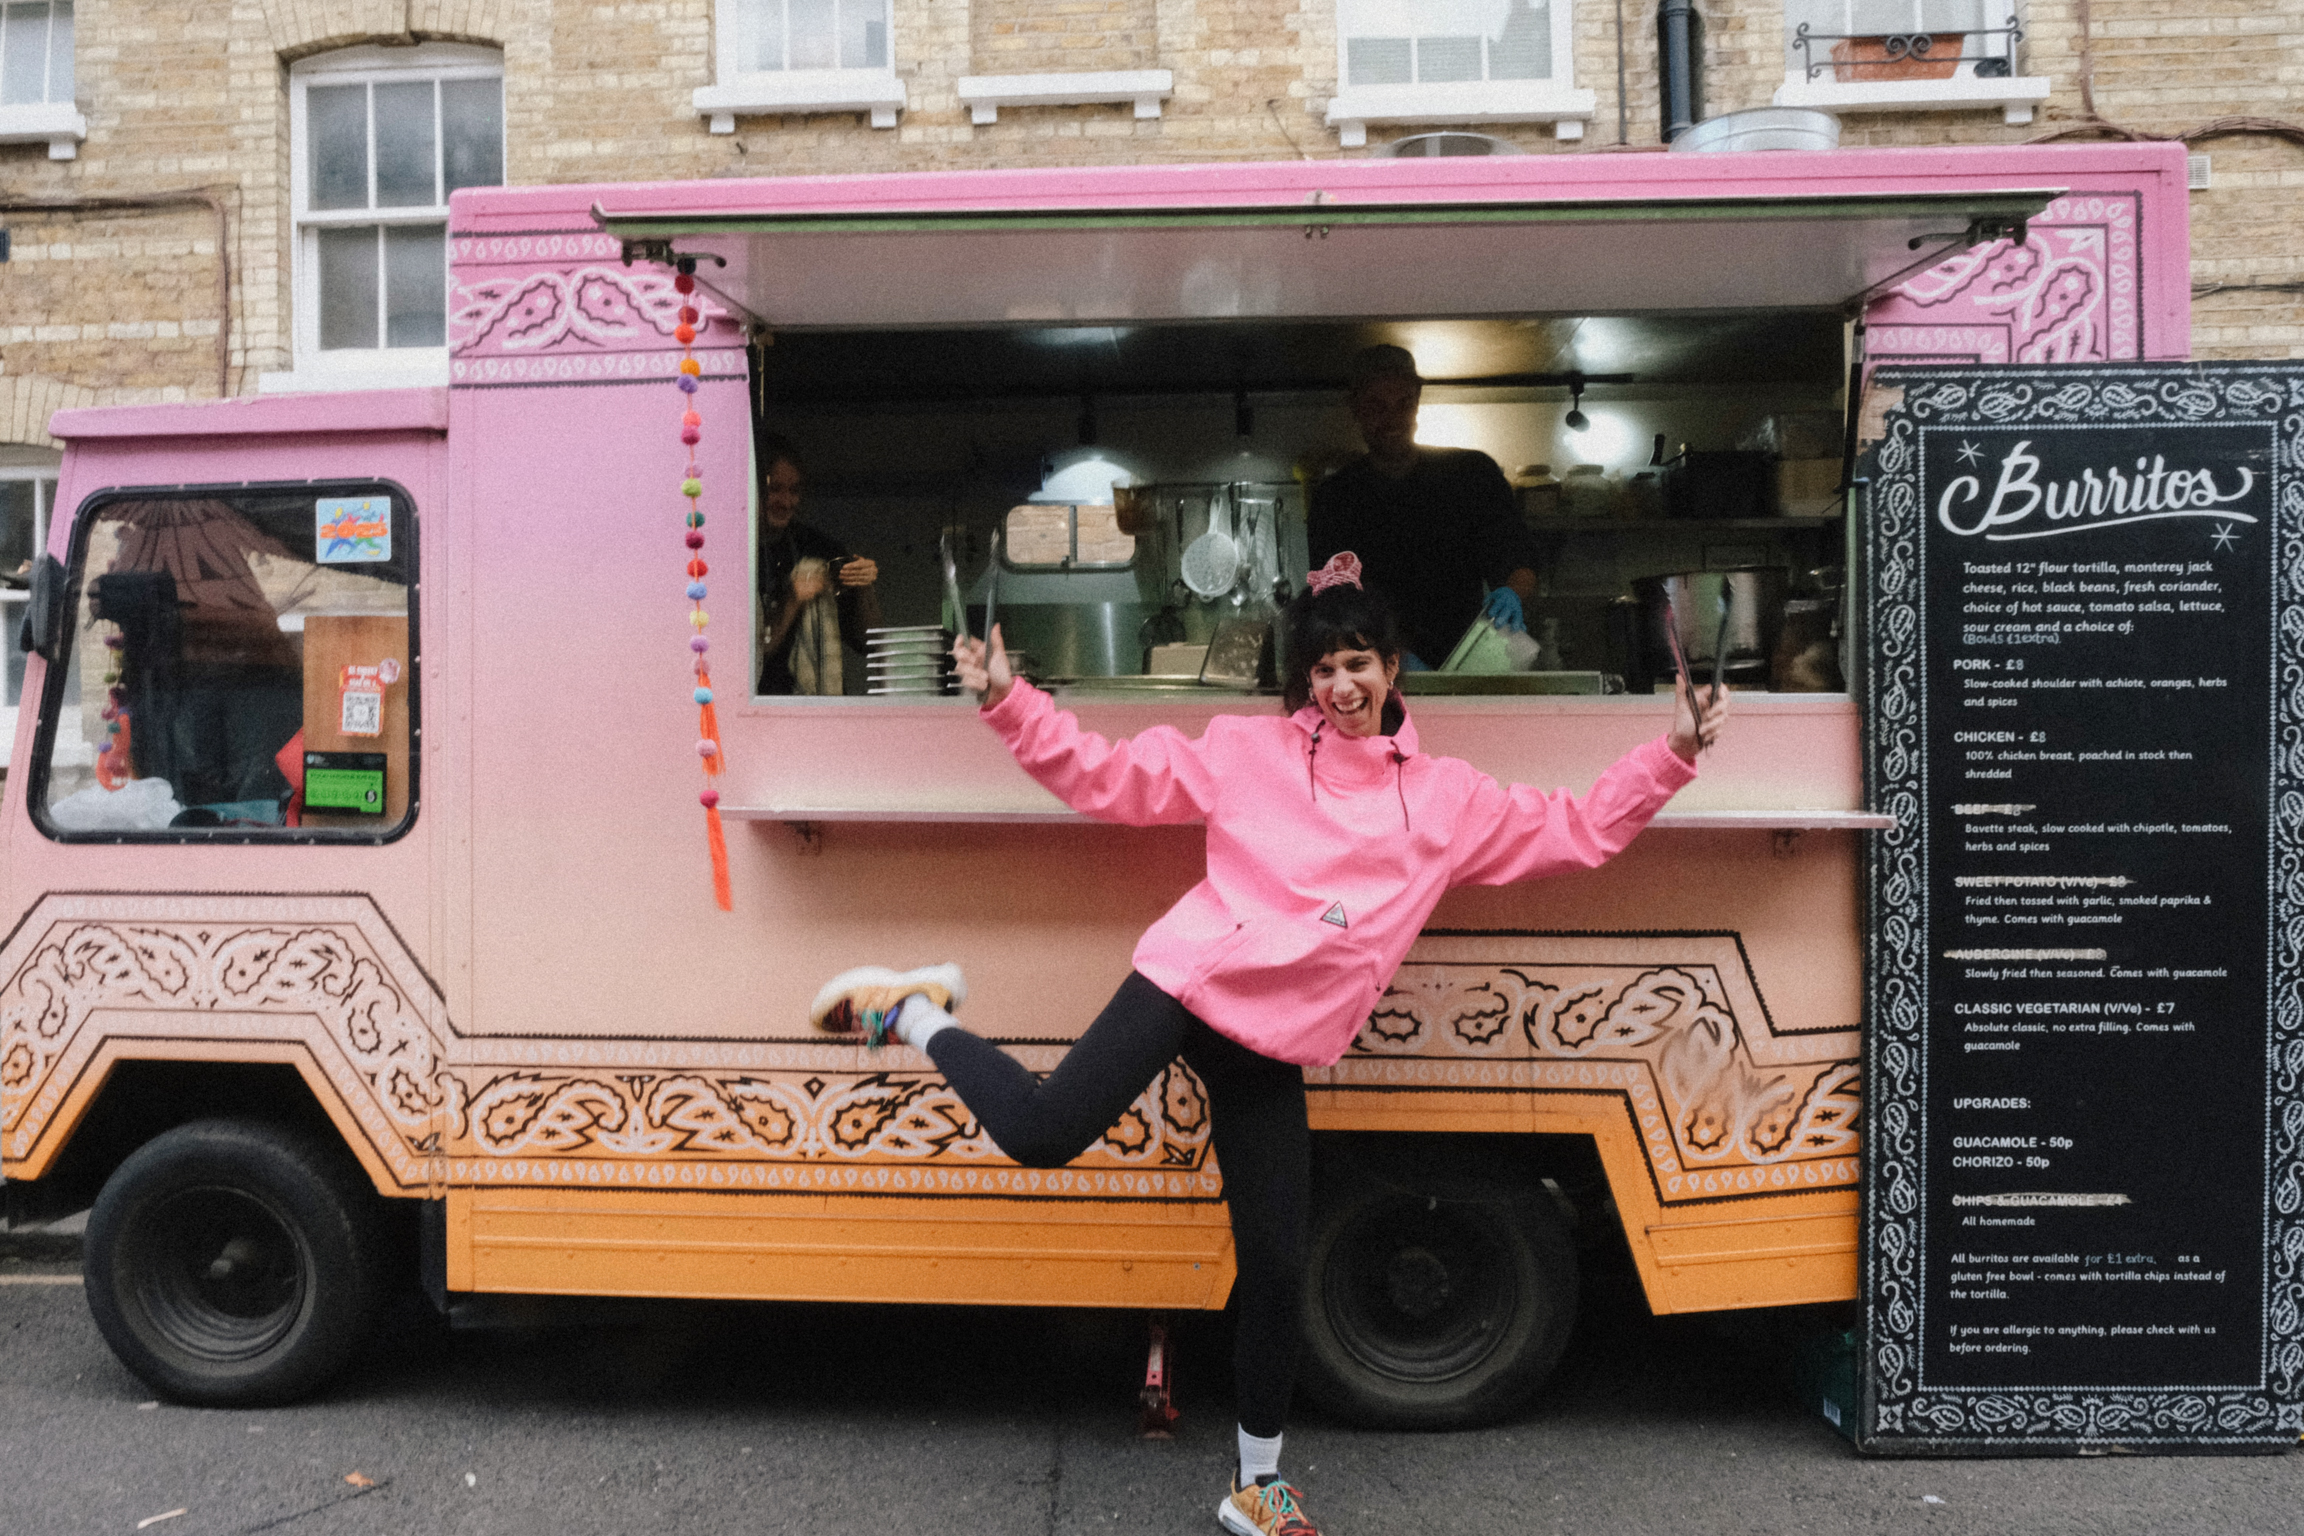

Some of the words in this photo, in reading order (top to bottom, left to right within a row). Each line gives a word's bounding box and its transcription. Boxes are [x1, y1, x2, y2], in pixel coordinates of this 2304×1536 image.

[1938, 440, 2254, 536] Burritos
[1963, 561, 2012, 574] Toasted
[2016, 562, 2036, 574] 12"
[2038, 561, 2069, 577] flour
[2072, 561, 2120, 575] tortilla,
[2124, 562, 2184, 576] monterey
[2187, 561, 2213, 575] jack
[1962, 582, 2007, 595] cheese,
[2042, 581, 2075, 593] black
[2079, 581, 2120, 594] beans,
[2123, 580, 2156, 595] fresh
[2158, 580, 2222, 593] coriander,
[1963, 602, 2002, 613] choice
[2005, 601, 2019, 616] of
[2021, 601, 2043, 613] hot
[2046, 603, 2085, 614] sauce,
[2088, 601, 2135, 613] tomato
[2138, 600, 2175, 613] salsa,
[2179, 600, 2225, 613] lettuce,
[1963, 624, 1990, 633] sour
[1992, 623, 2032, 633] cream
[2034, 620, 2061, 633] and
[2062, 623, 2073, 633] a
[2074, 620, 2115, 632] choice
[2117, 620, 2134, 635] of:
[1953, 658, 1991, 671] PORK
[2005, 658, 2024, 671] £8
[1964, 678, 2029, 689] Slow-cooked
[2031, 678, 2077, 689] shoulder
[2079, 678, 2103, 688] with
[2105, 677, 2146, 688] achiote,
[2150, 679, 2195, 690] oranges,
[2198, 677, 2228, 687] herbs
[1963, 696, 1985, 707] and
[1987, 697, 2018, 709] spices
[1954, 731, 2015, 743] CHICKEN
[2030, 731, 2046, 743] £8
[1965, 750, 1994, 761] 100%
[1997, 750, 2037, 761] chicken
[2039, 750, 2075, 762] breast,
[2078, 750, 2123, 763] poached
[2124, 752, 2136, 760] in
[2138, 750, 2165, 760] stock
[2168, 750, 2193, 760] then
[1965, 769, 2012, 779] shredded
[1965, 823, 2004, 834] Bavette
[2007, 823, 2038, 834] steak,
[2042, 823, 2066, 833] slow
[2067, 823, 2105, 833] cooked
[2106, 823, 2131, 833] with
[2132, 822, 2177, 834] chipotle,
[2181, 823, 2232, 834] tomatoes,
[1964, 841, 1994, 852] herbs
[1995, 841, 2017, 852] and
[2019, 842, 2050, 853] spices
[2005, 876, 2057, 888] POTATO
[1965, 895, 1992, 906] Fried
[1993, 896, 2018, 906] then
[2020, 895, 2054, 906] tossed
[2056, 895, 2080, 905] with
[2082, 895, 2115, 908] garlic,
[2119, 895, 2158, 906] smoked
[2159, 895, 2201, 908] paprika
[2203, 895, 2212, 905] &
[1964, 914, 2000, 927] thyme.
[2003, 914, 2038, 924] Comes
[2041, 913, 2064, 924] with
[2066, 913, 2123, 926] guacamole
[1965, 968, 2000, 981] Slowly
[2001, 968, 2027, 980] fried
[2029, 968, 2053, 978] then
[2056, 968, 2106, 978] seasoned.
[2109, 969, 2143, 978] Comes
[2147, 967, 2170, 977] with
[2172, 967, 2227, 980] guacamole
[1954, 1003, 2012, 1014] CLASSIC
[2016, 1002, 2101, 1014] VEGETARIAN
[2104, 1003, 2142, 1015] (V/Ve)
[2157, 1002, 2175, 1013] £7
[1964, 1022, 2010, 1032] Absolute
[2011, 1022, 2049, 1033] classic,
[2052, 1024, 2067, 1032] no
[2068, 1023, 2096, 1032] extra
[2098, 1021, 2132, 1035] filling.
[2135, 1022, 2170, 1032] Comes
[2172, 1022, 2195, 1032] with
[1963, 1040, 2021, 1053] guacamole
[1953, 1097, 2031, 1109] UPGRADES:
[1953, 1136, 2037, 1148] GUACAMOLE
[2049, 1136, 2073, 1149] 50p
[1952, 1156, 2014, 1168] CHORIZO
[2026, 1156, 2050, 1169] 50p
[1952, 1195, 1993, 1207] CHIPS
[2010, 1194, 2095, 1207] GUACAMOLE
[1962, 1216, 1976, 1226] All
[1979, 1216, 2035, 1226] homemade
[1950, 1252, 1966, 1264] All
[1968, 1253, 2009, 1264] burritos
[2013, 1254, 2029, 1263] are
[2033, 1253, 2079, 1263] available
[2085, 1255, 2103, 1267] for
[2107, 1253, 2122, 1264] £1
[2177, 1254, 2191, 1263] as
[2192, 1254, 2201, 1263] a
[1950, 1271, 1983, 1284] gluten
[1985, 1271, 2006, 1284] free
[2008, 1271, 2034, 1281] bowl
[2044, 1273, 2076, 1281] comes
[2079, 1271, 2103, 1281] with
[2104, 1270, 2142, 1281] tortilla
[2143, 1271, 2171, 1283] chips
[2173, 1270, 2213, 1281] instead
[2214, 1270, 2226, 1283] of
[1949, 1289, 1967, 1299] the
[1970, 1289, 2009, 1299] tortilla.
[1949, 1324, 1958, 1337] If
[1960, 1326, 1980, 1337] you
[1982, 1326, 2000, 1335] are
[2002, 1324, 2041, 1338] allergic
[2043, 1326, 2055, 1335] to
[2110, 1324, 2144, 1336] please
[2146, 1324, 2175, 1335] check
[2177, 1324, 2201, 1334] with
[2203, 1326, 2216, 1334] us
[1949, 1342, 1982, 1355] before
[1984, 1343, 2031, 1355] ordering.
